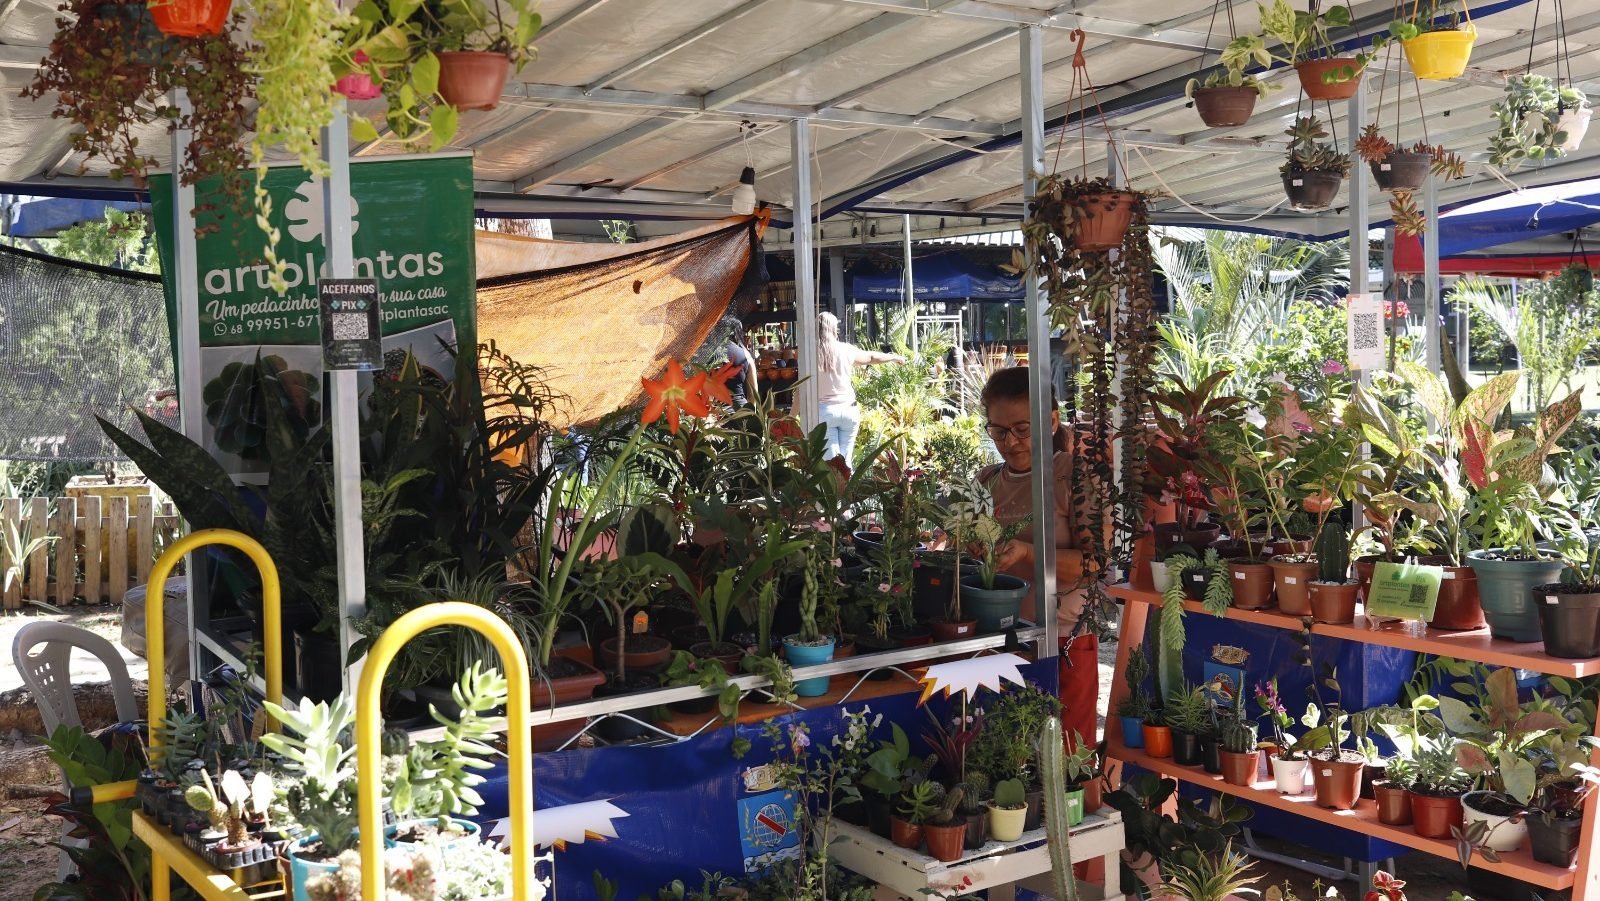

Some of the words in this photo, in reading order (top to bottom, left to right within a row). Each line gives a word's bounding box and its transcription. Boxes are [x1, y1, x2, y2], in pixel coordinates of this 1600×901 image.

[322, 284, 375, 294] ACEITAMOS
[205, 299, 241, 321] Um
[241, 293, 319, 320] pedacinho
[389, 289, 416, 303] sua
[417, 286, 448, 301] casa
[341, 300, 357, 310] PIX
[230, 324, 244, 335] 68
[246, 314, 320, 332] 99951-671
[380, 304, 449, 323] tplantasac
